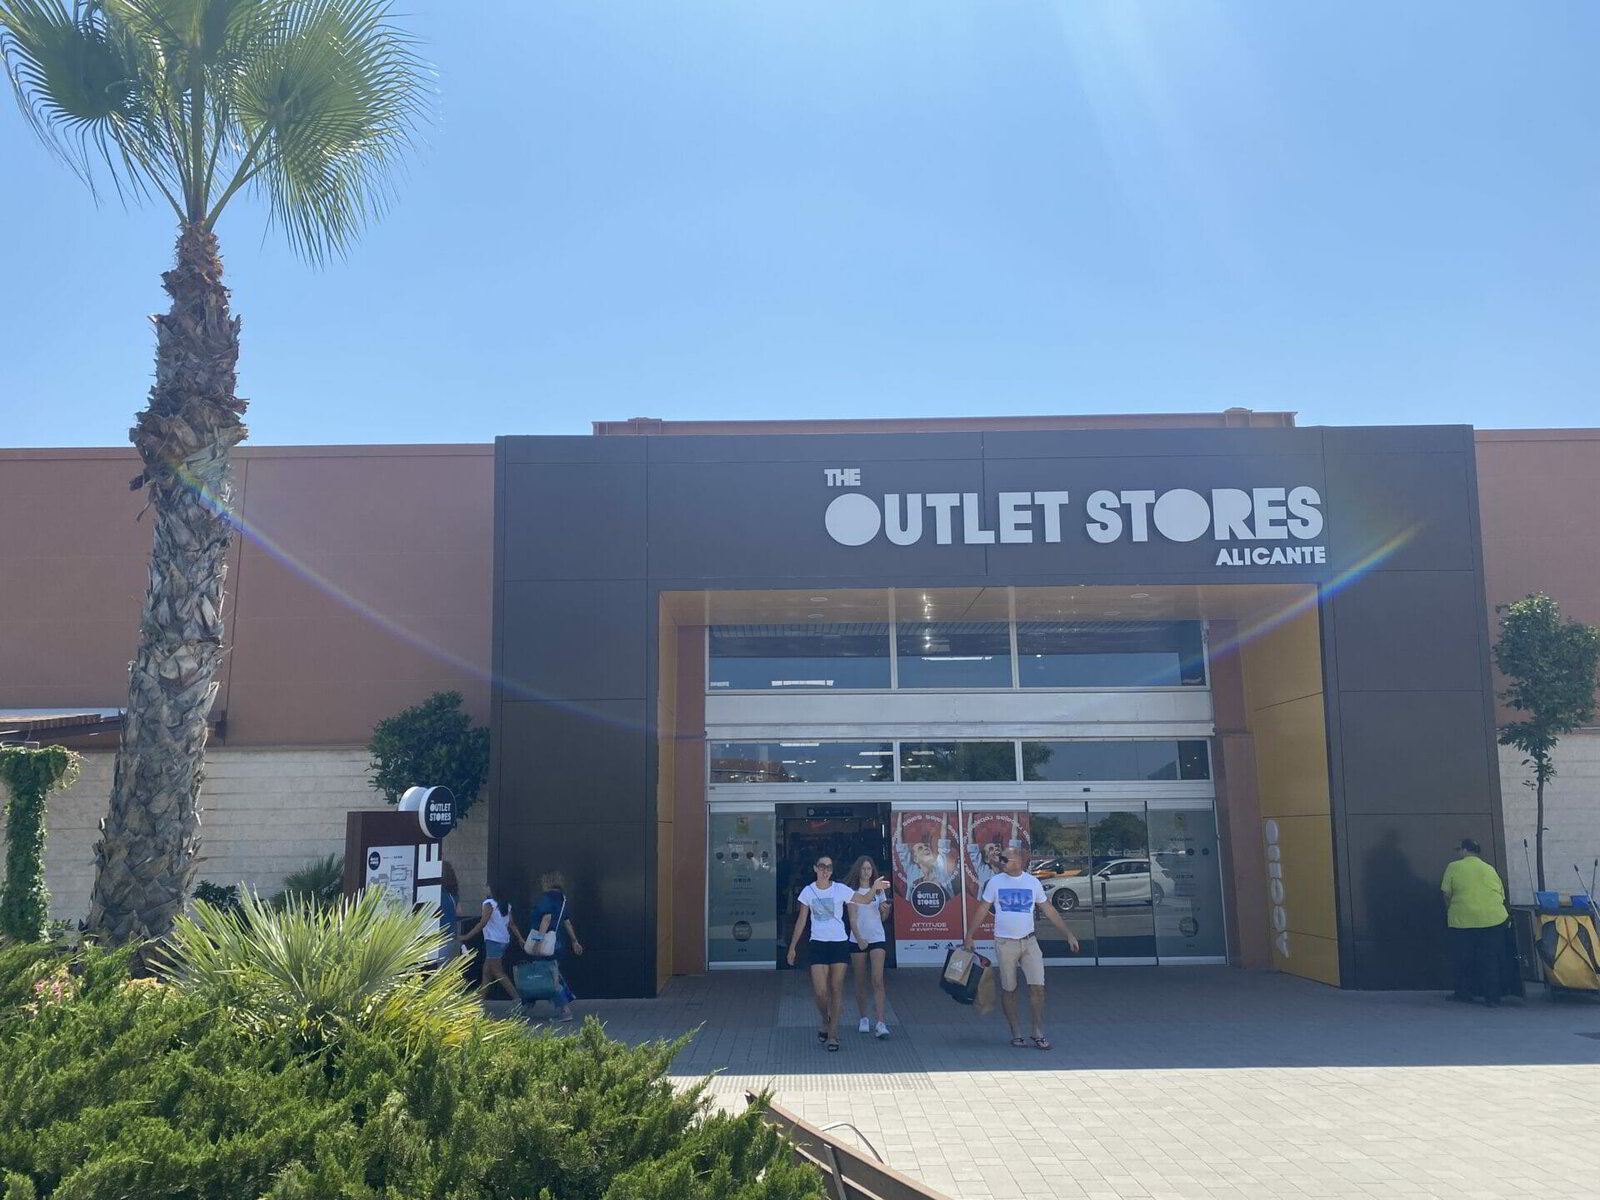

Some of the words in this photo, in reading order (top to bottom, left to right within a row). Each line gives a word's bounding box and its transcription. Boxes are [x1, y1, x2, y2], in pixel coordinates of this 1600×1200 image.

[824, 468, 861, 486] THE
[825, 491, 1069, 546] OUTLET
[1086, 486, 1323, 544] STORES
[1216, 546, 1326, 566] ALICANTE
[429, 803, 451, 812] OUTLET
[429, 812, 452, 822] STORES
